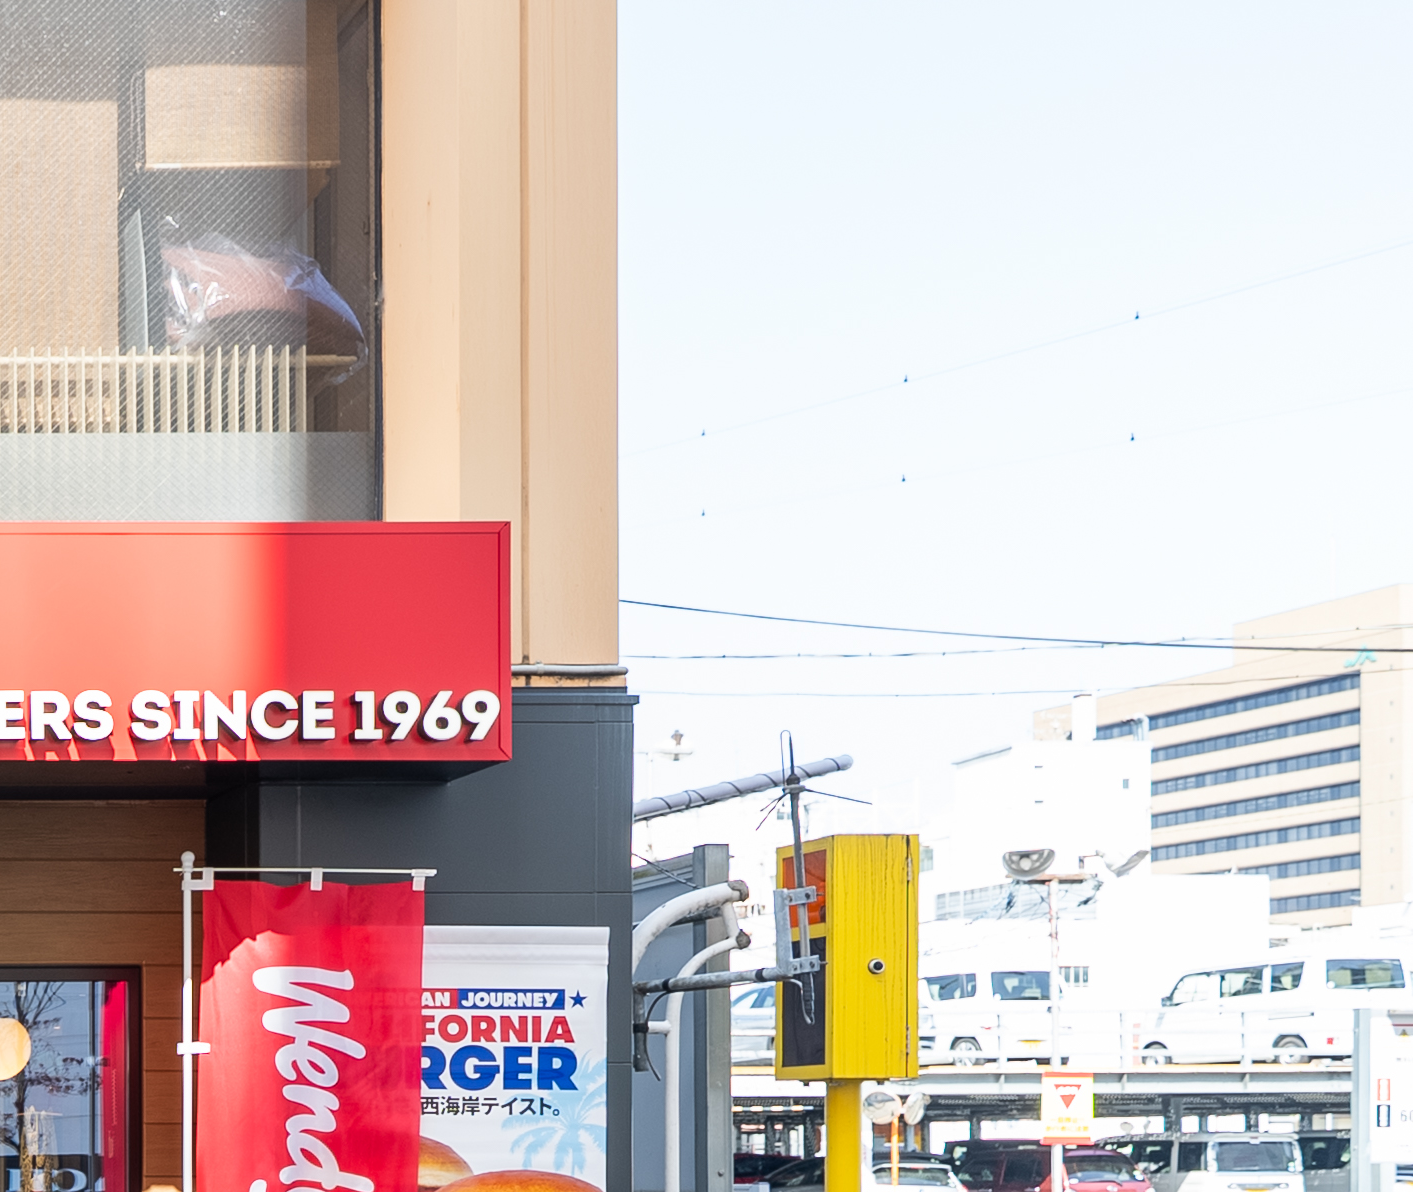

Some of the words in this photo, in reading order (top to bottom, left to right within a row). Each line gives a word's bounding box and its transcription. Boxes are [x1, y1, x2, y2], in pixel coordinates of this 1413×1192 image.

[130, 688, 336, 742] SINCE
[353, 689, 501, 741] 1969
[461, 991, 558, 1007] JOURNEY
